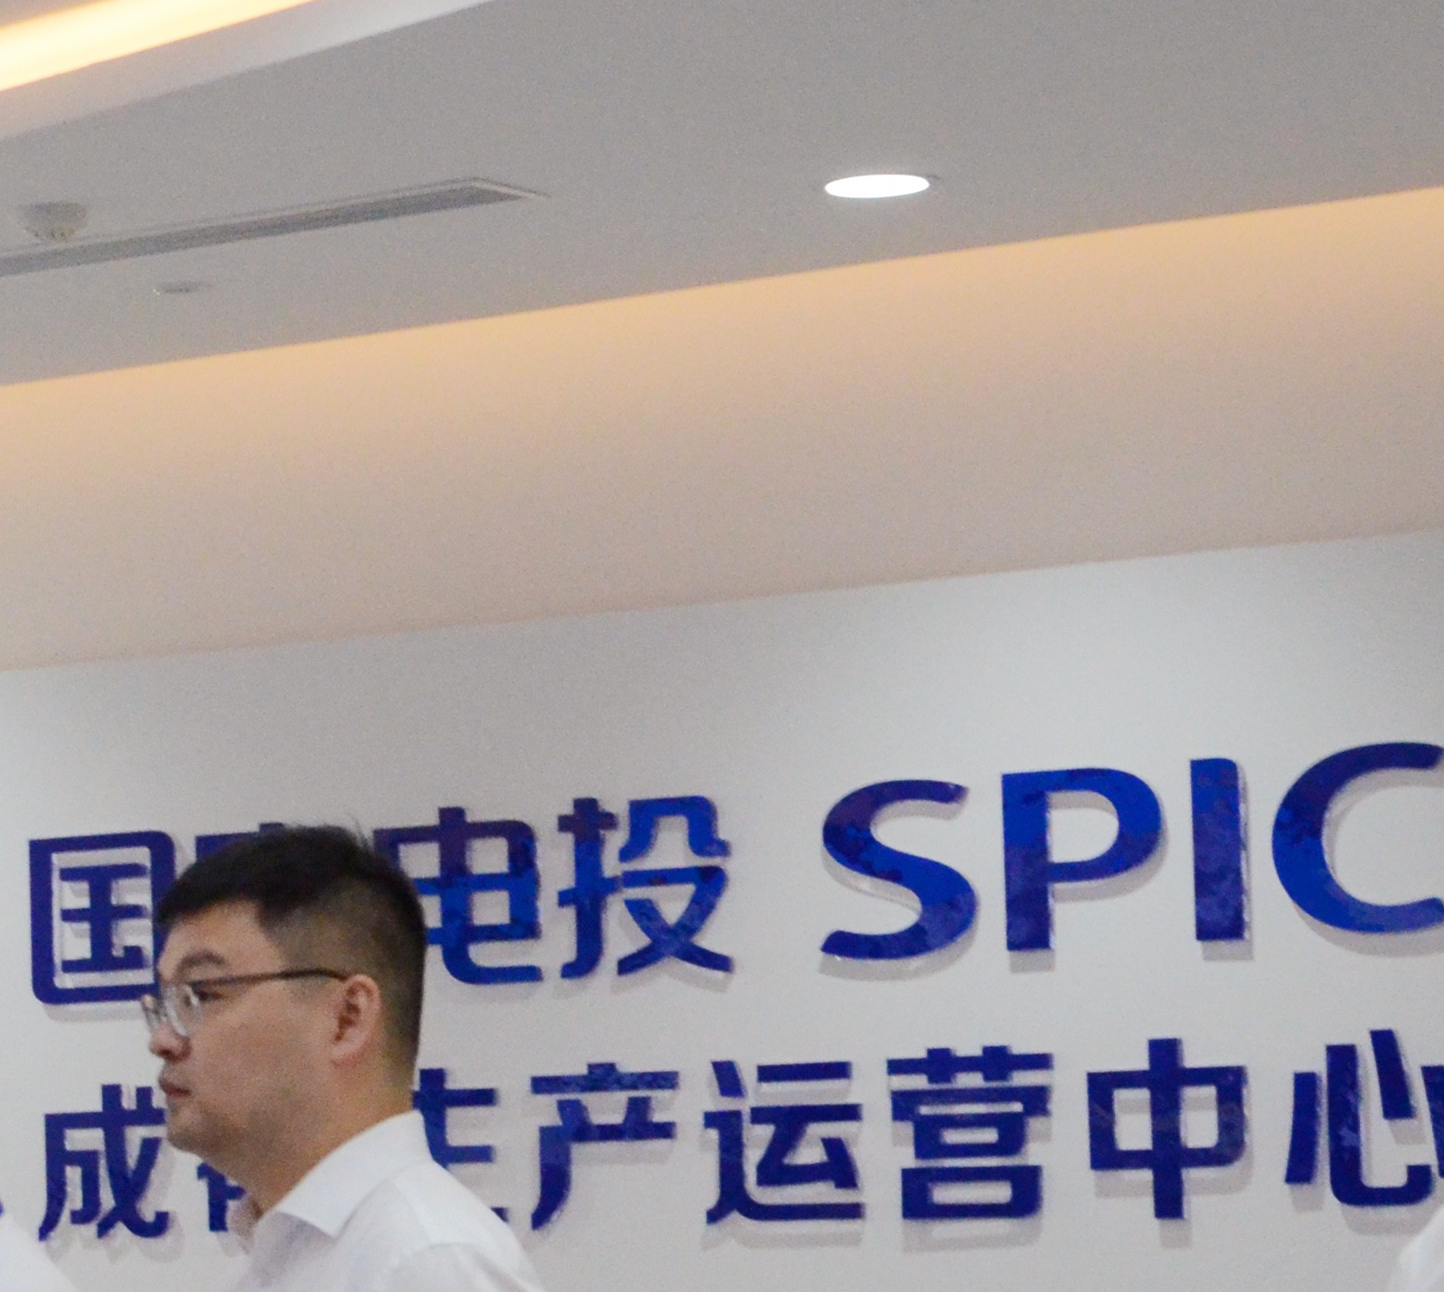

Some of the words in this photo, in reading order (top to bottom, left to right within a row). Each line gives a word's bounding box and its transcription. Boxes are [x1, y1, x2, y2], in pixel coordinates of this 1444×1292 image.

[29, 796, 734, 1006] 国电投
[820, 742, 1444, 961] SPIC
[38, 1029, 1444, 1241] 成产运营中心
